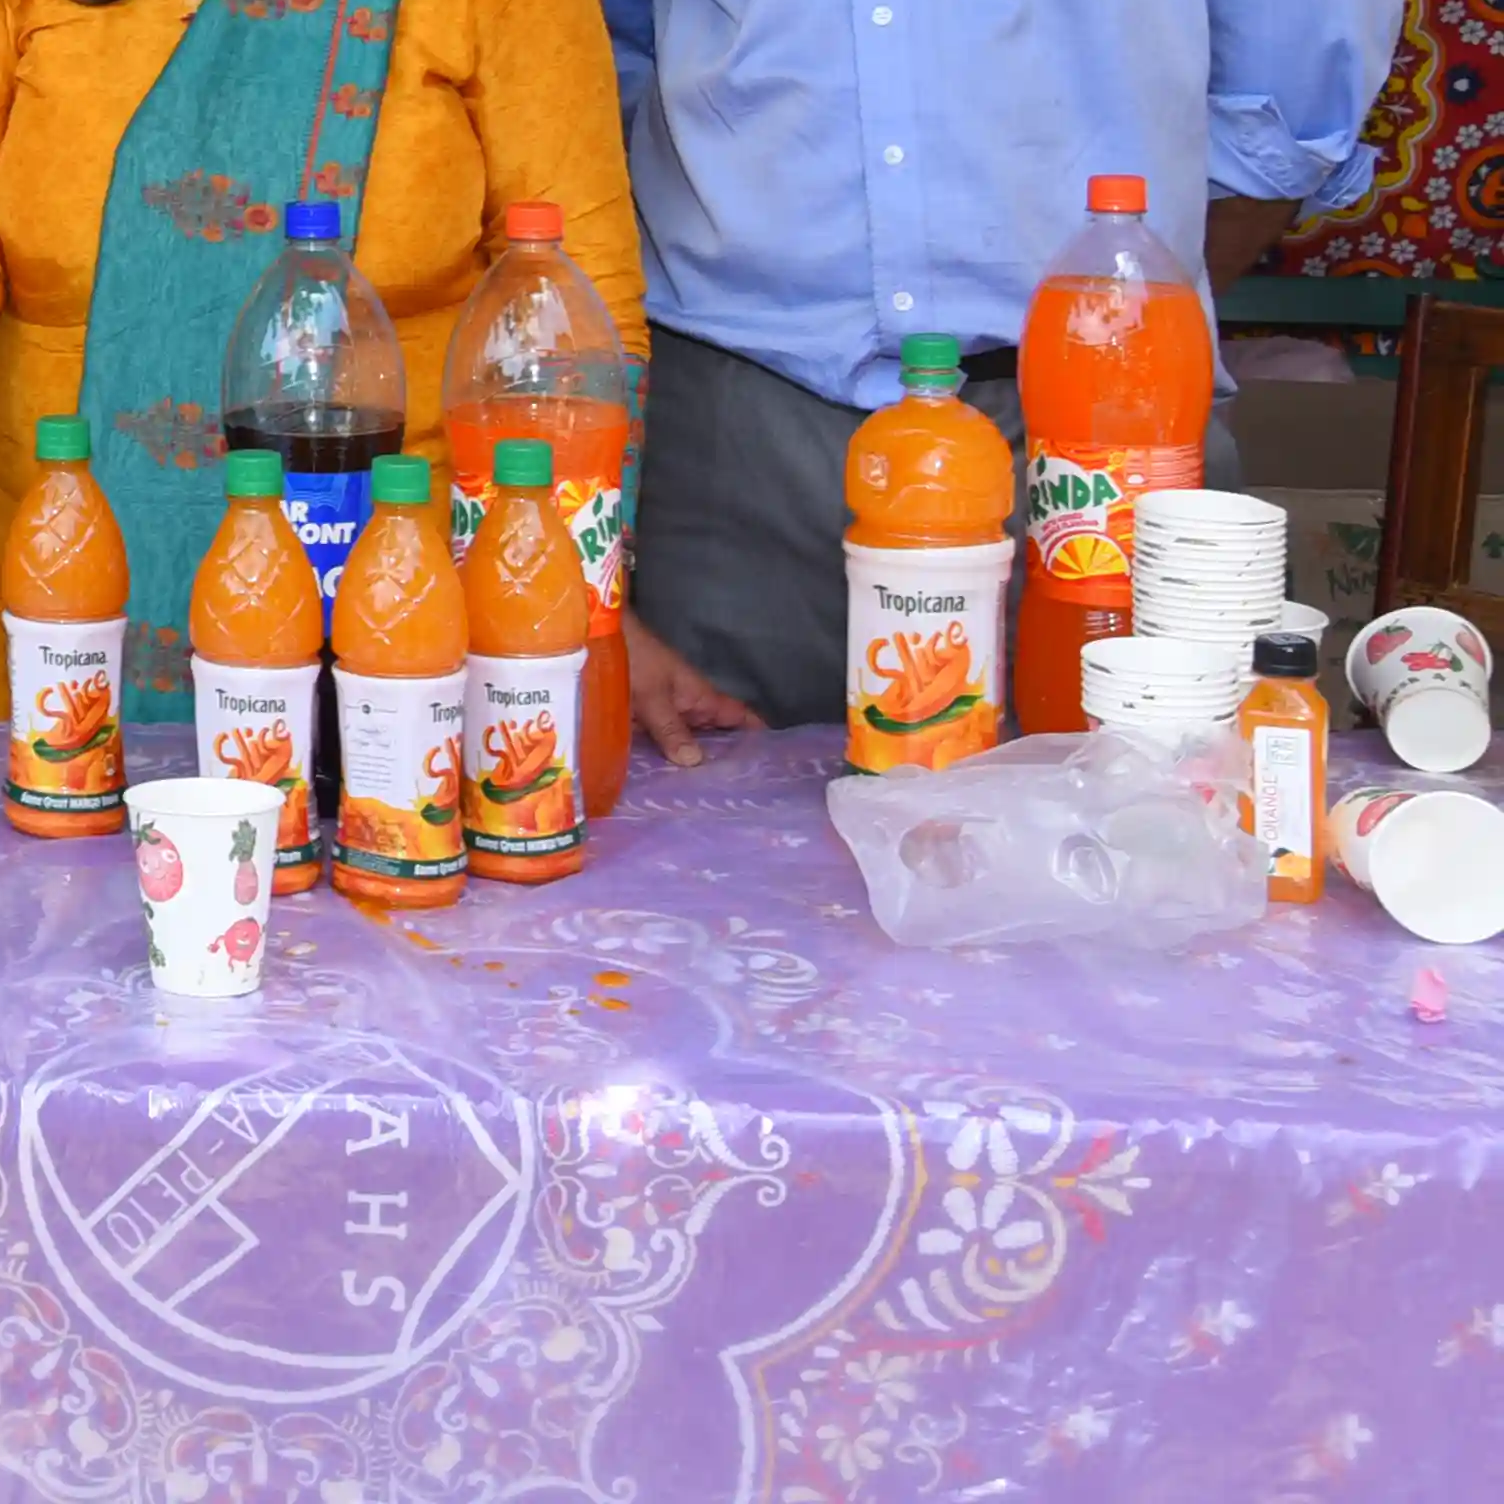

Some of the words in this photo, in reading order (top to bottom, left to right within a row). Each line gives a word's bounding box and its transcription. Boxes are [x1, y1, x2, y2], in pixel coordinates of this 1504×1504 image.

[1028, 473, 1120, 526] RINDA
[872, 584, 967, 617] Tropicana
[38, 645, 107, 671] Tropicana
[866, 620, 970, 709] Slice
[35, 669, 111, 737] Slice
[215, 688, 286, 715] Tropicana
[429, 700, 464, 725] Tropi
[483, 682, 551, 708] Tropicana
[213, 717, 292, 780] Slice
[482, 709, 556, 781] Slice
